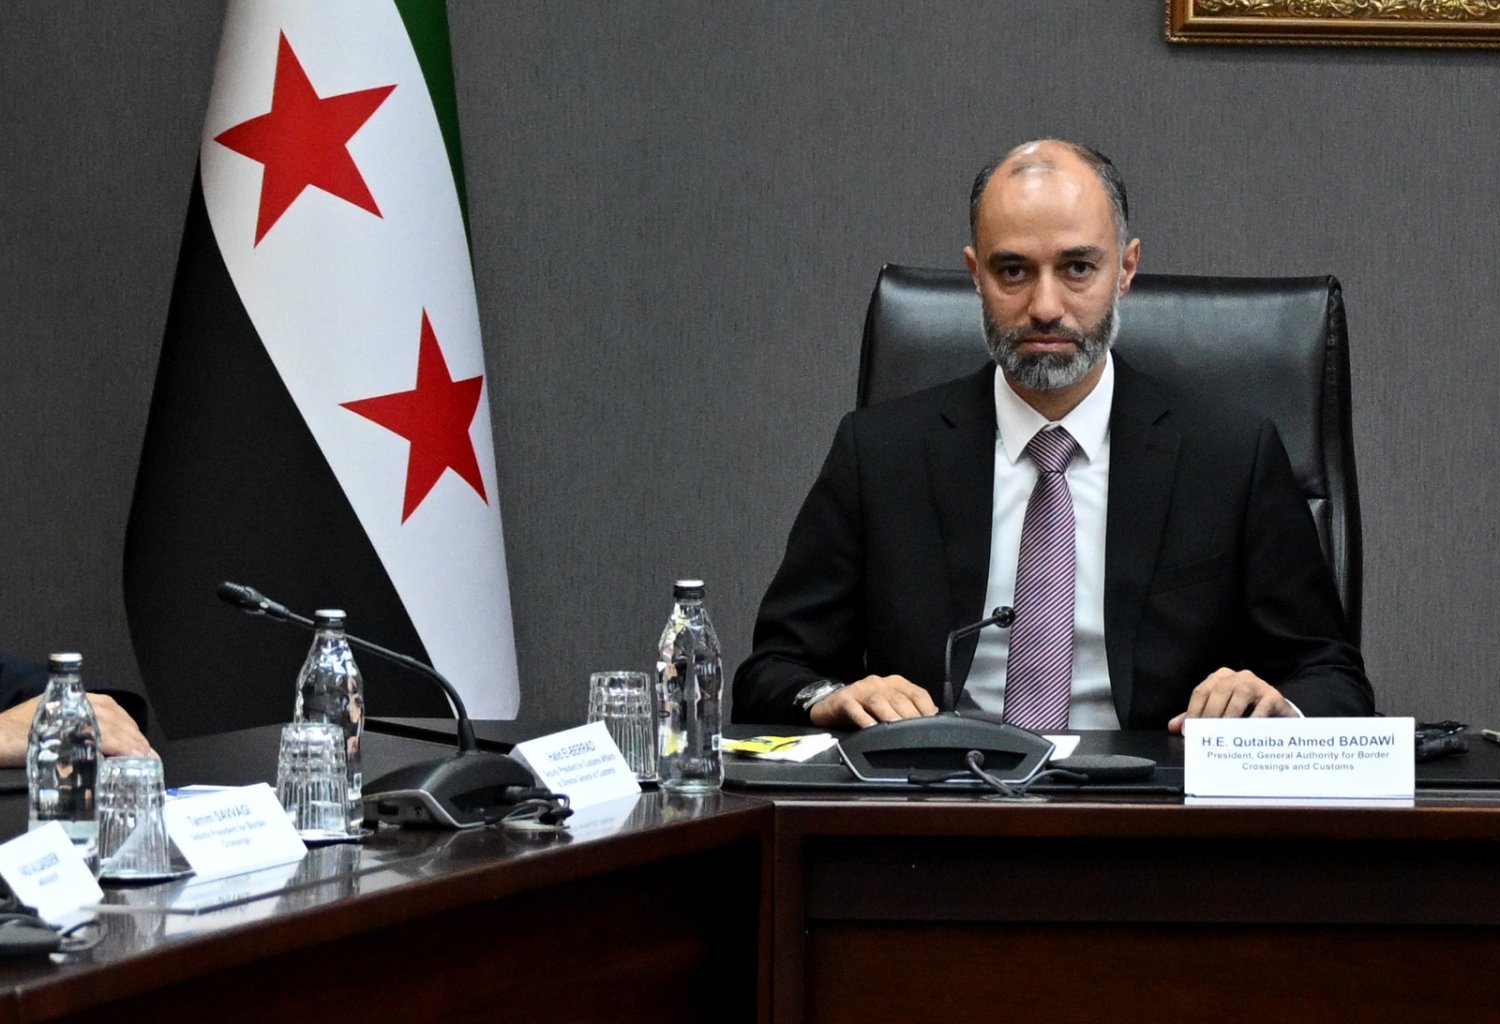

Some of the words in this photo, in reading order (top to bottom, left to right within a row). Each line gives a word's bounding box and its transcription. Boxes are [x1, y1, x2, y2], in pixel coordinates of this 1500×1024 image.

[1202, 736, 1228, 747] H.E.
[1233, 736, 1284, 748] Qutaiba
[1288, 736, 1335, 747] Ahmed
[1257, 751, 1293, 759] General
[1296, 751, 1339, 761] Authority
[1342, 750, 1355, 759] for
[1357, 750, 1390, 759] Border
[1242, 762, 1290, 772] Crossings
[1293, 762, 1310, 770] and
[1313, 762, 1355, 770] Customs
